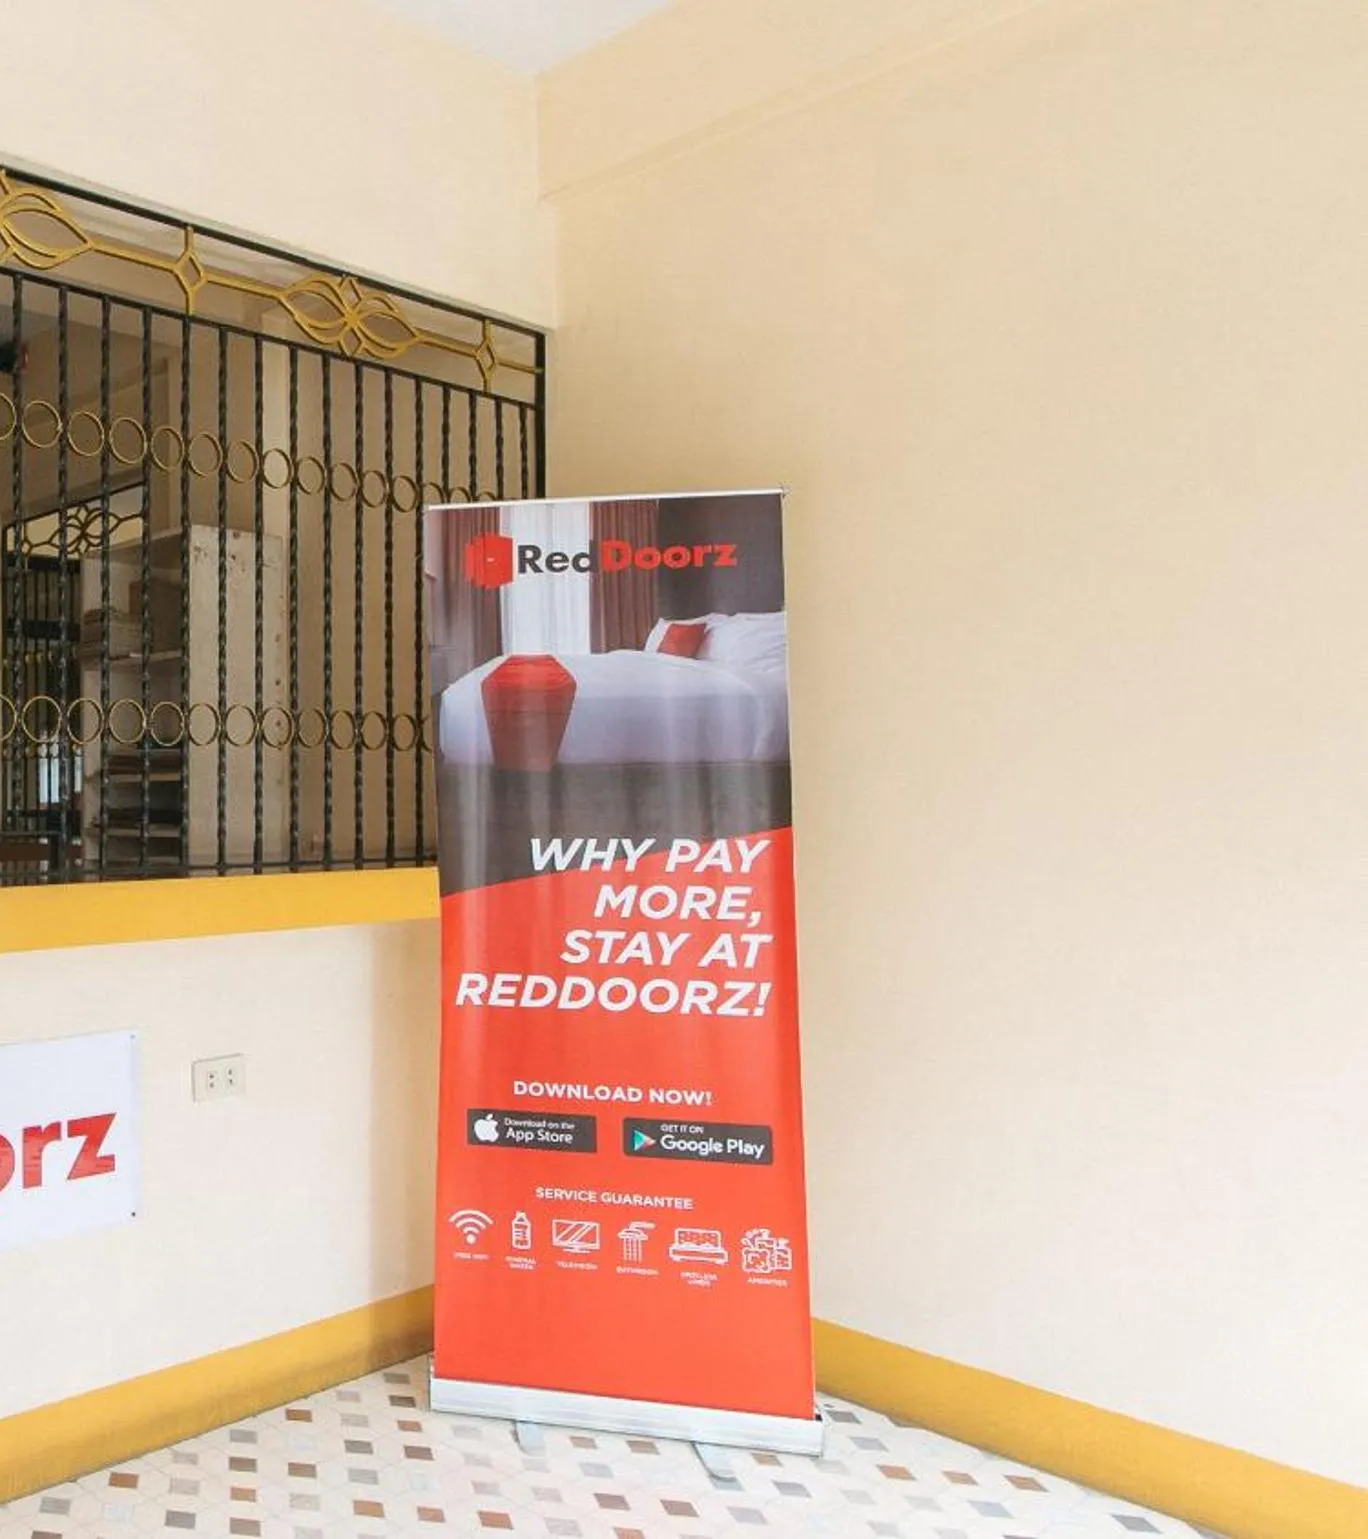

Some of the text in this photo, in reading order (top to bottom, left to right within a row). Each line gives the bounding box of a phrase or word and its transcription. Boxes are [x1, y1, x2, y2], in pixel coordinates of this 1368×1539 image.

[517, 538, 738, 574] RedDoorz
[531, 838, 771, 873] WHY PAY
[593, 884, 762, 928] MORE,
[559, 929, 774, 969] STAY AT
[454, 973, 773, 1018] REDDOORZ!
[513, 1080, 713, 1107] DOWNLOAD NOW!
[504, 1117, 546, 1128] Download
[506, 1127, 574, 1144] App Store
[660, 1123, 704, 1134] GET IT ON
[660, 1134, 765, 1159] Google Play
[535, 1186, 694, 1210] SERVICE GUARANTEE
